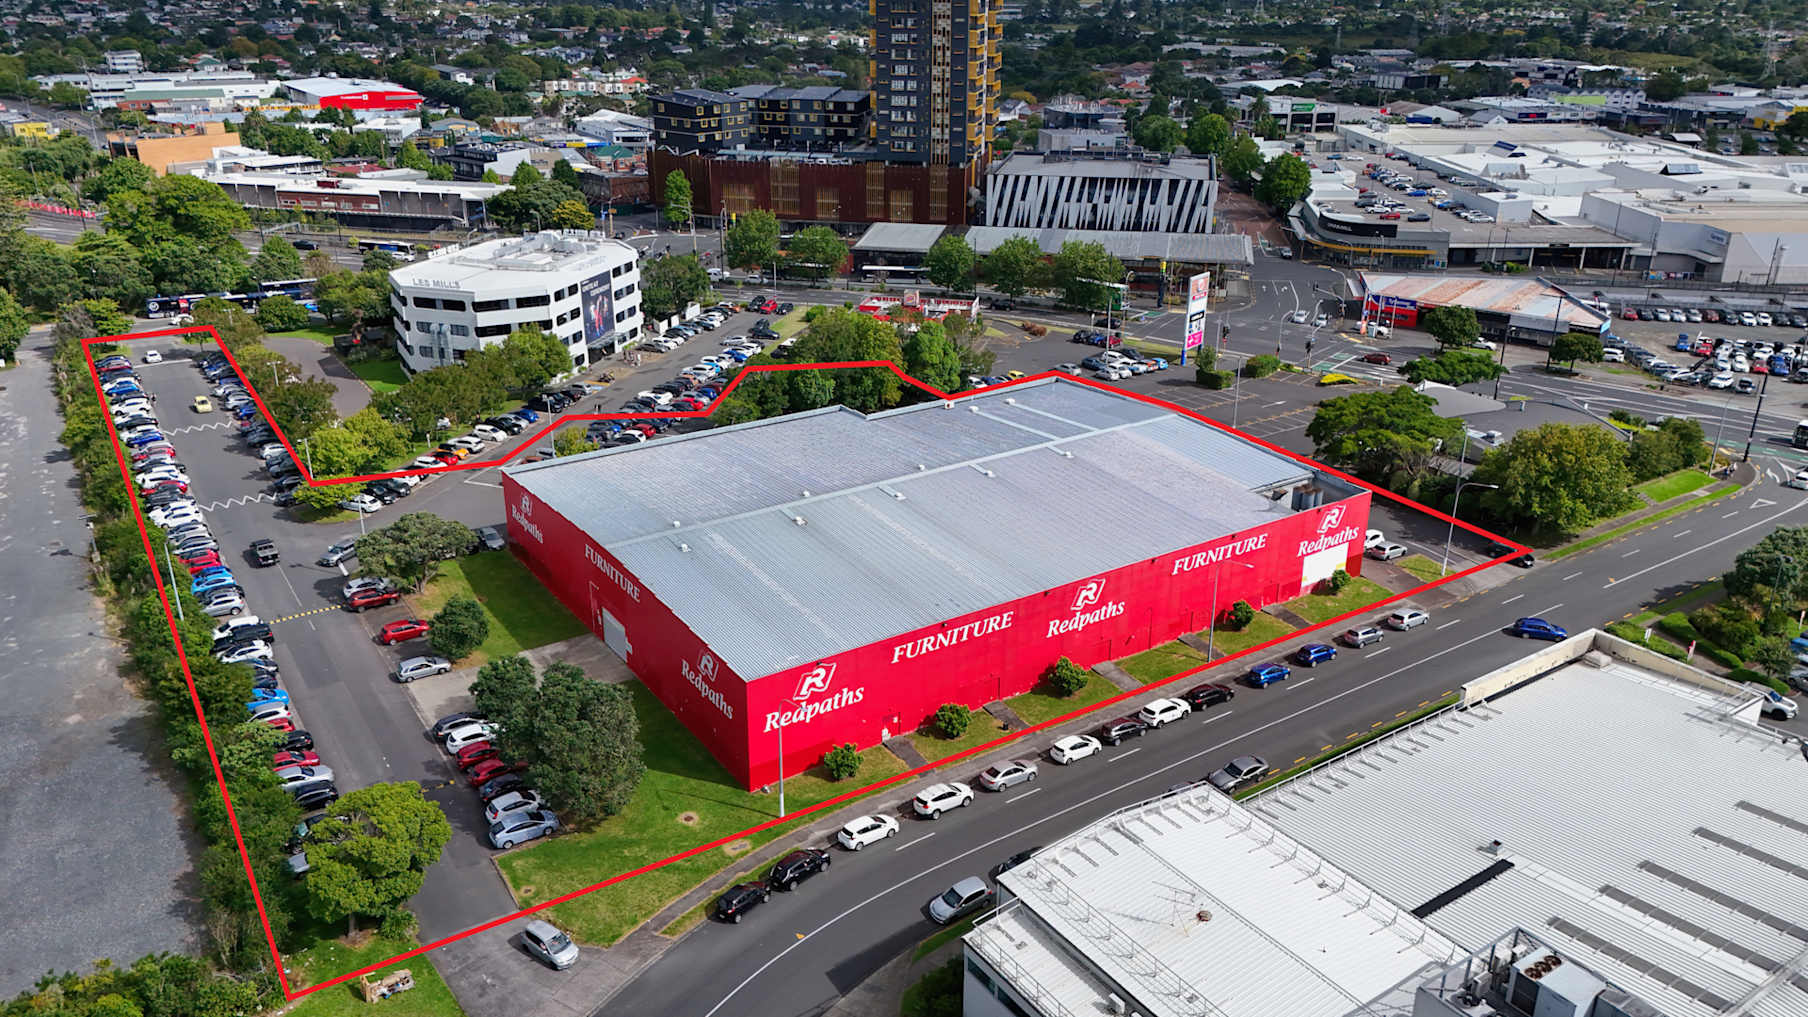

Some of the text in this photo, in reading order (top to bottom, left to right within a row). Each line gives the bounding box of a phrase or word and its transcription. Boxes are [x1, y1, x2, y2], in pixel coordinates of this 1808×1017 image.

[412, 278, 461, 289] LES MILLS
[511, 504, 544, 544] Redpaths
[1297, 526, 1359, 557] Redpaths
[585, 544, 640, 603] FURNITURE
[1171, 533, 1268, 575] FURNITURE
[891, 611, 1014, 664] FURNITURE
[1046, 599, 1125, 638] Redpaths
[681, 659, 733, 720] Redpaths
[763, 687, 864, 733] Redpaths
